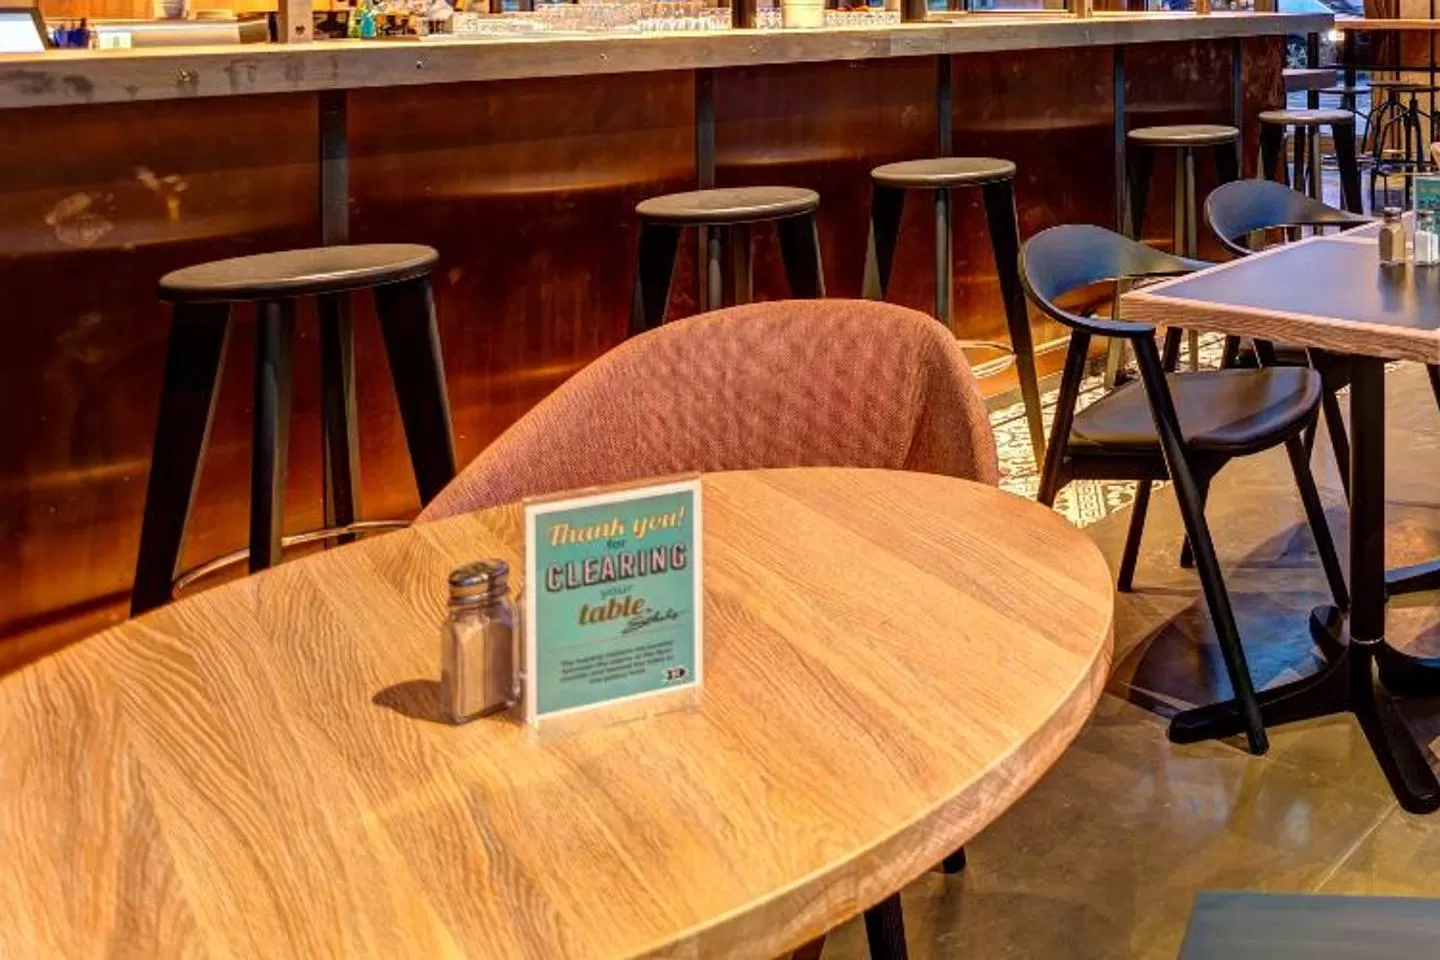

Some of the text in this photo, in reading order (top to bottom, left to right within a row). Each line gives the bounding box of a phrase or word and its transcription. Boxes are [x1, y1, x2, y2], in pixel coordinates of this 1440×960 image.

[550, 505, 686, 547] Thank you!
[546, 543, 687, 592] CLEARING
[578, 595, 646, 626] table
